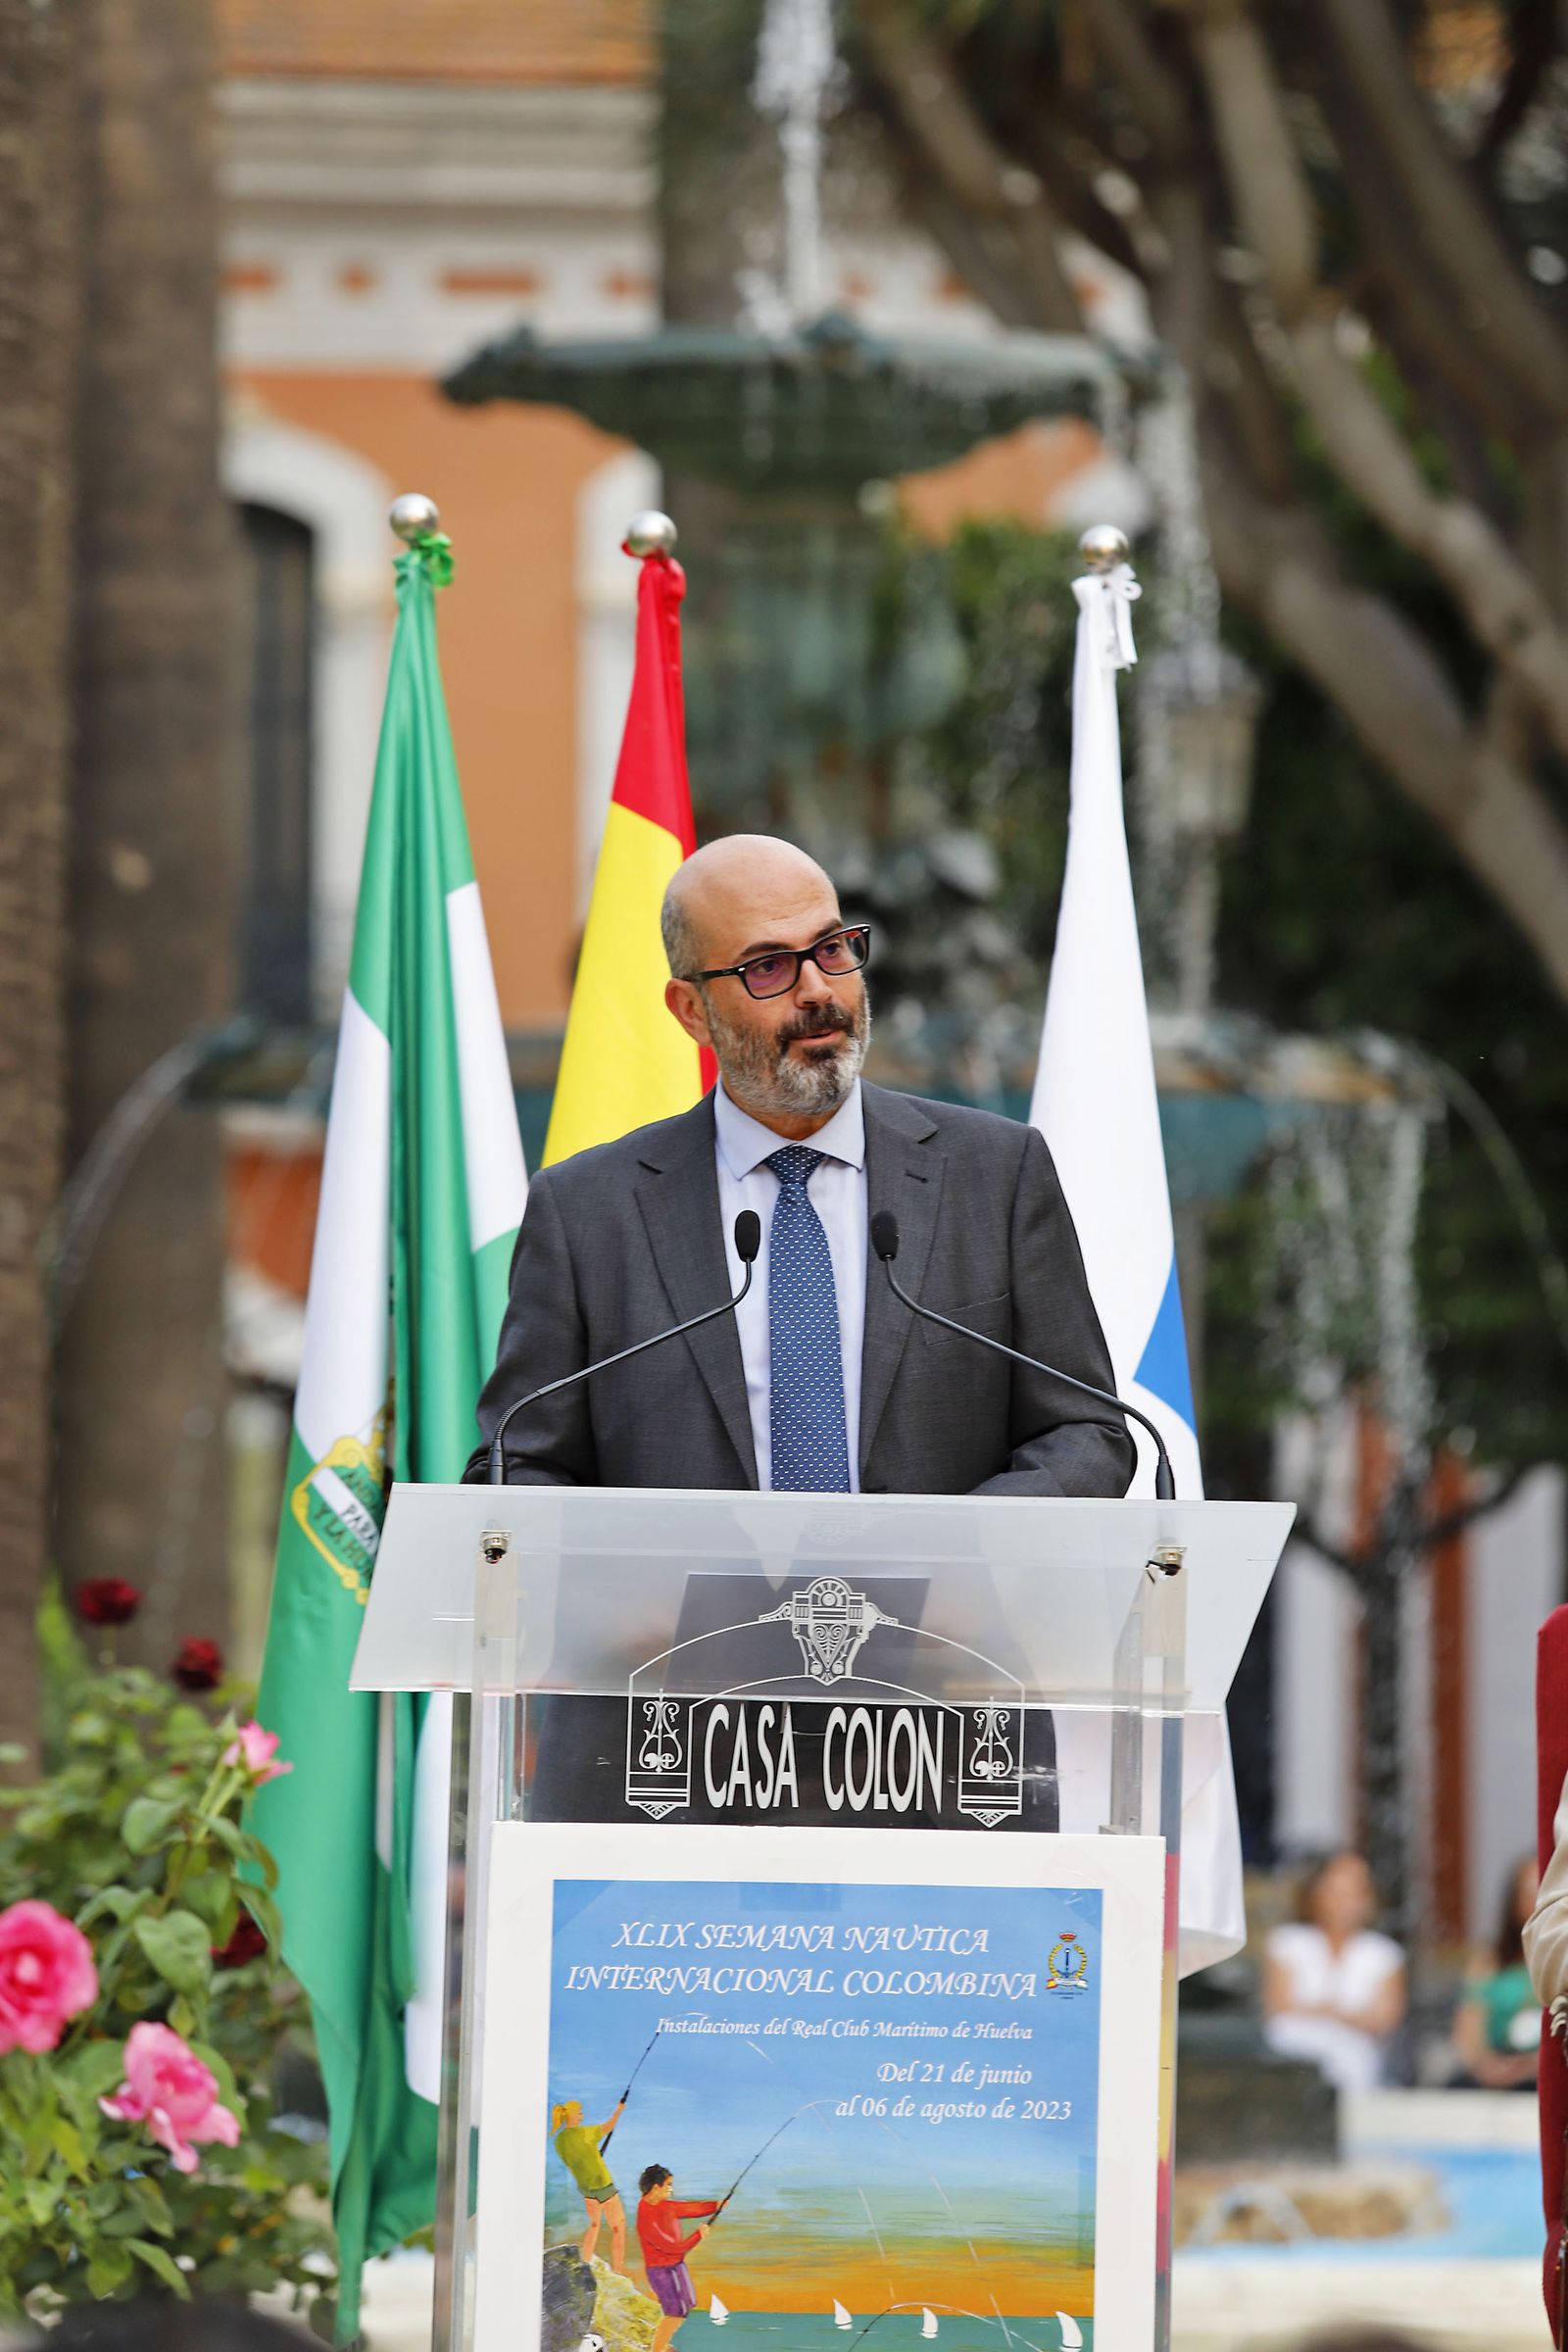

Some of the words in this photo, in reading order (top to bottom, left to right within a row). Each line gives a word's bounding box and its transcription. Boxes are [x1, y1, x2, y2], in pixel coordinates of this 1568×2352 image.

[704, 1702, 799, 1809] CASA
[823, 1706, 945, 1814] COLON
[612, 1921, 695, 1948] XLIX
[695, 1923, 835, 1952] SEMANA
[843, 1925, 989, 1955] NAUTICA
[564, 1964, 834, 1996] INTERNACIONAL
[843, 1969, 1037, 2000] COLOMBINA
[656, 2016, 760, 2035] Instalaciones
[763, 2018, 787, 2035] del
[791, 2019, 828, 2038] Real
[831, 2020, 869, 2038] Club
[952, 2022, 971, 2038] de
[972, 2023, 1033, 2039] Huelva
[876, 2060, 920, 2082] Del
[920, 2063, 946, 2082] 21
[951, 2062, 974, 2083] de
[973, 2064, 1033, 2090] junio
[835, 2095, 861, 2117] al
[861, 2097, 889, 2117] 06
[892, 2095, 914, 2118] de
[920, 2099, 986, 2125] agosto
[992, 2097, 1016, 2119] de
[1020, 2100, 1072, 2120] 2023
